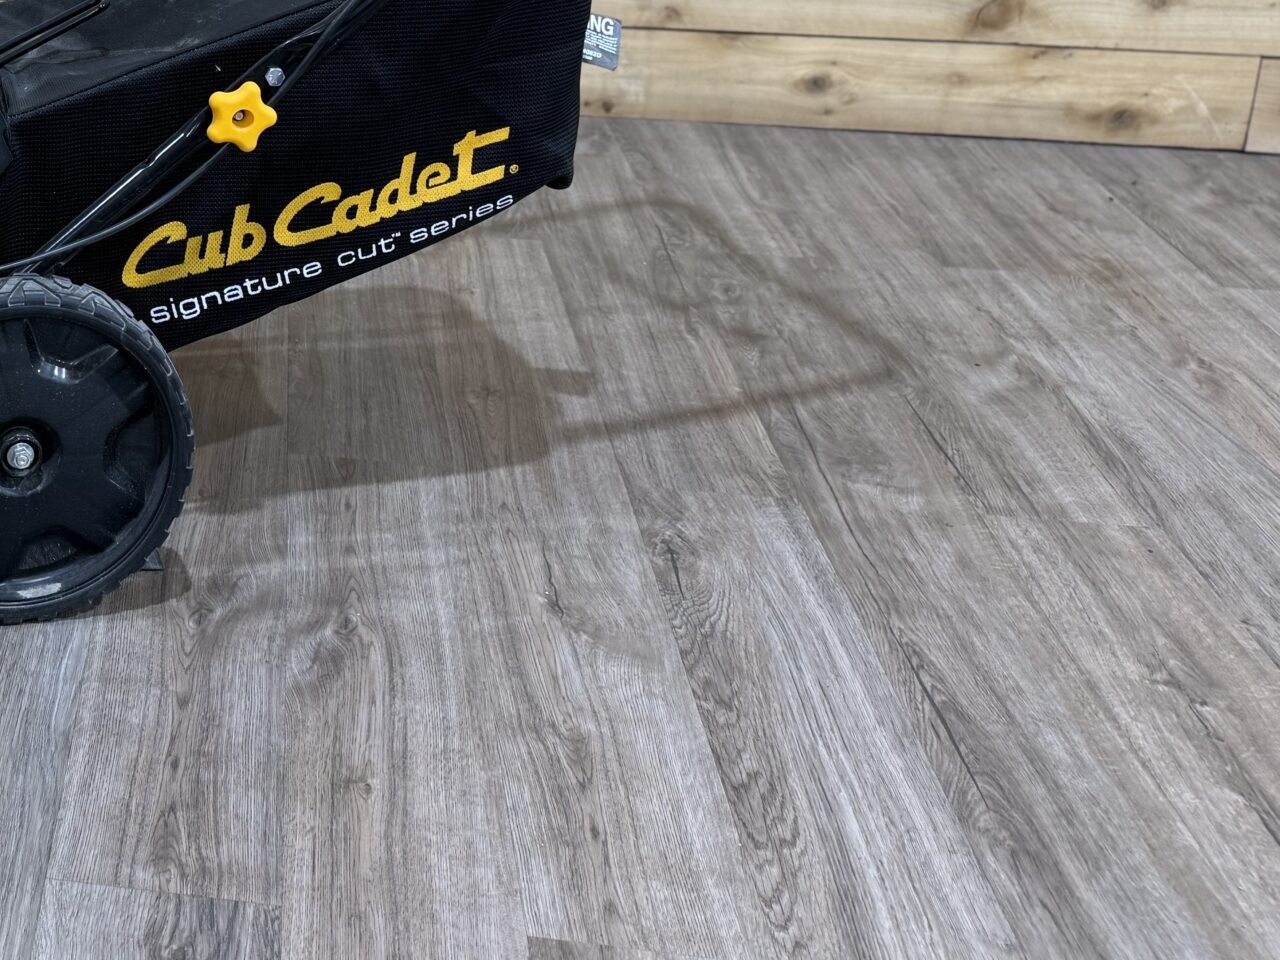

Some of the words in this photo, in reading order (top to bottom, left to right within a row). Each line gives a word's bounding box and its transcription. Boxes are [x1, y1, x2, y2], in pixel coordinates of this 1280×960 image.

[122, 204, 267, 288] Cub
[274, 127, 510, 246] Cadet
[150, 261, 322, 324] signature
[409, 194, 514, 244] series
